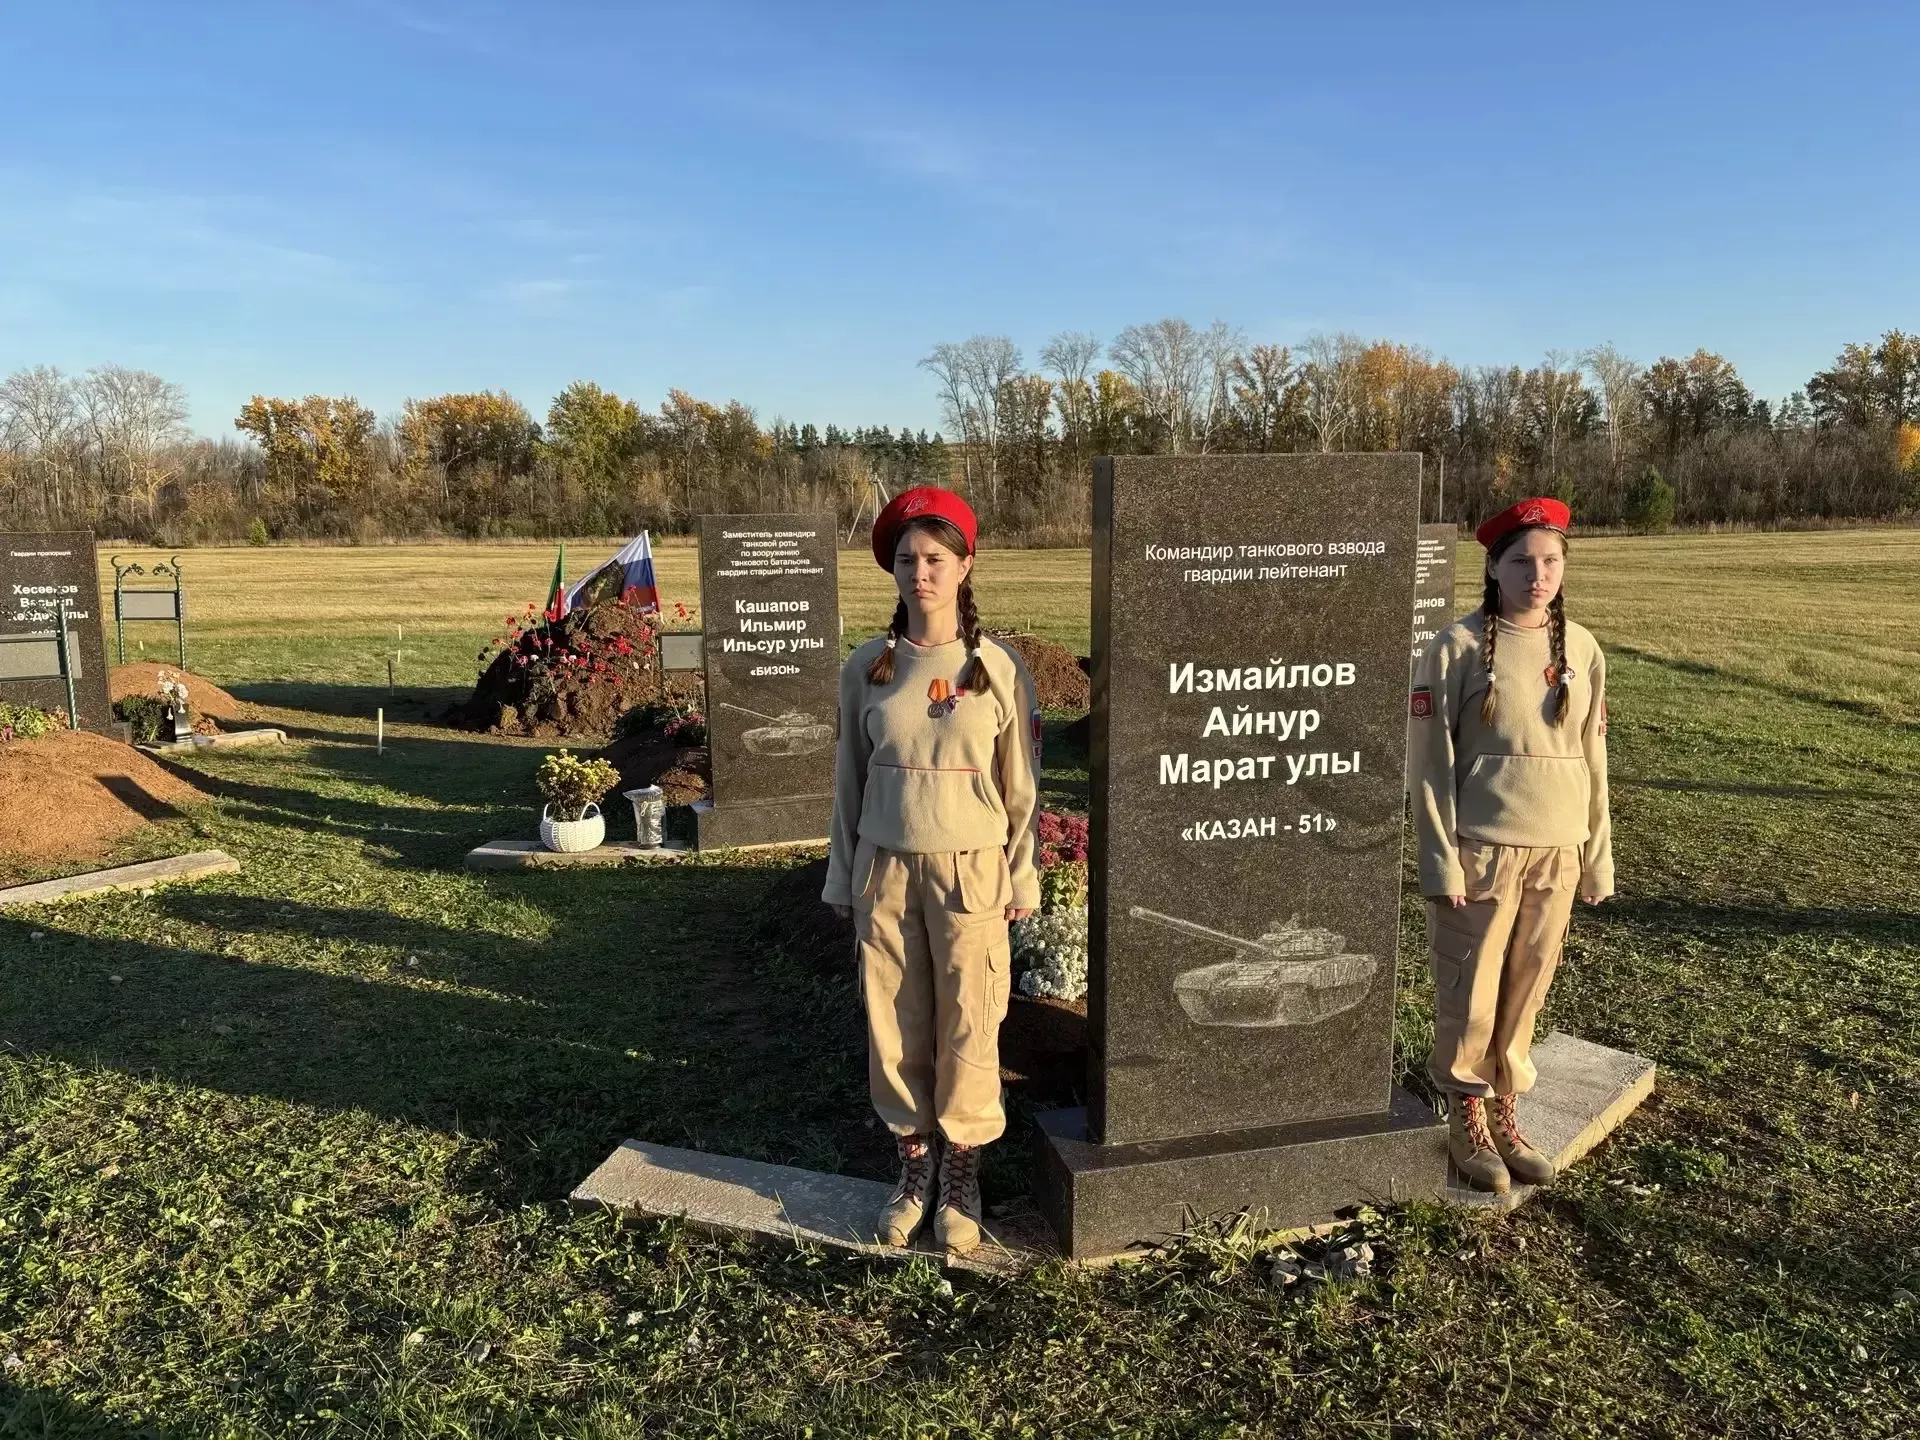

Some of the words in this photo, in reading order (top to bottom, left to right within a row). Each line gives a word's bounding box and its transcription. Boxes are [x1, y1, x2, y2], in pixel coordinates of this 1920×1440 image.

[722, 530, 773, 539] Заместитель
[774, 530, 816, 539] командира
[742, 539, 777, 548] танковой
[778, 540, 798, 548] роты
[1145, 544, 1233, 562] Командир
[1238, 542, 1323, 558] танкового
[1328, 540, 1386, 556] взвода
[751, 549, 800, 558] вооружению
[770, 557, 811, 566] батальона
[716, 569, 748, 578] гвардии
[750, 567, 783, 577] старший
[784, 566, 824, 575] лейтенант
[1184, 567, 1253, 585] гвардии
[1258, 562, 1348, 581] лейтенант
[735, 599, 810, 614] Кашапов
[740, 618, 807, 634] Ильмир
[723, 638, 786, 654] Ильсур
[789, 637, 824, 653] улы
[750, 665, 801, 677] «БИЗОН»
[1169, 657, 1356, 694] Измайлов
[1202, 704, 1320, 742] Айнур
[1159, 754, 1276, 789] Марат
[1286, 750, 1361, 786] улы
[1181, 816, 1276, 842] «КАЗАН
[1298, 813, 1337, 834] 51»
